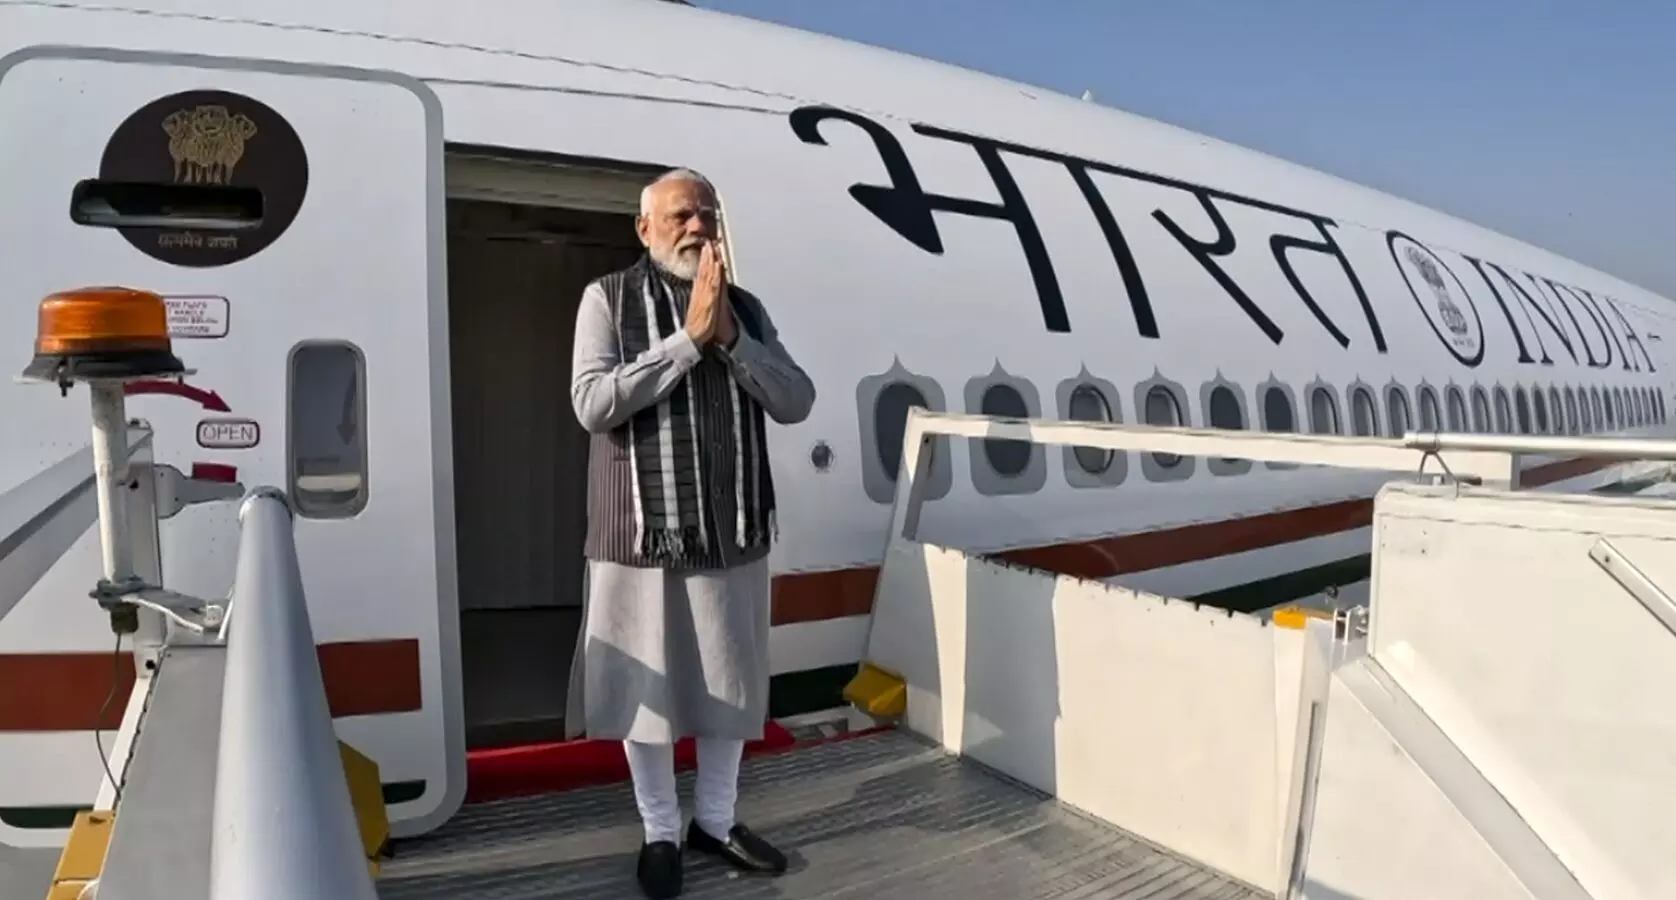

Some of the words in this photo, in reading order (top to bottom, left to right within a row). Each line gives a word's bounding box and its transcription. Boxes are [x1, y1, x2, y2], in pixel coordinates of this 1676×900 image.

[788, 105, 1388, 354] भारत
[1459, 252, 1657, 373] INDIA
[202, 426, 254, 441] OPEN
